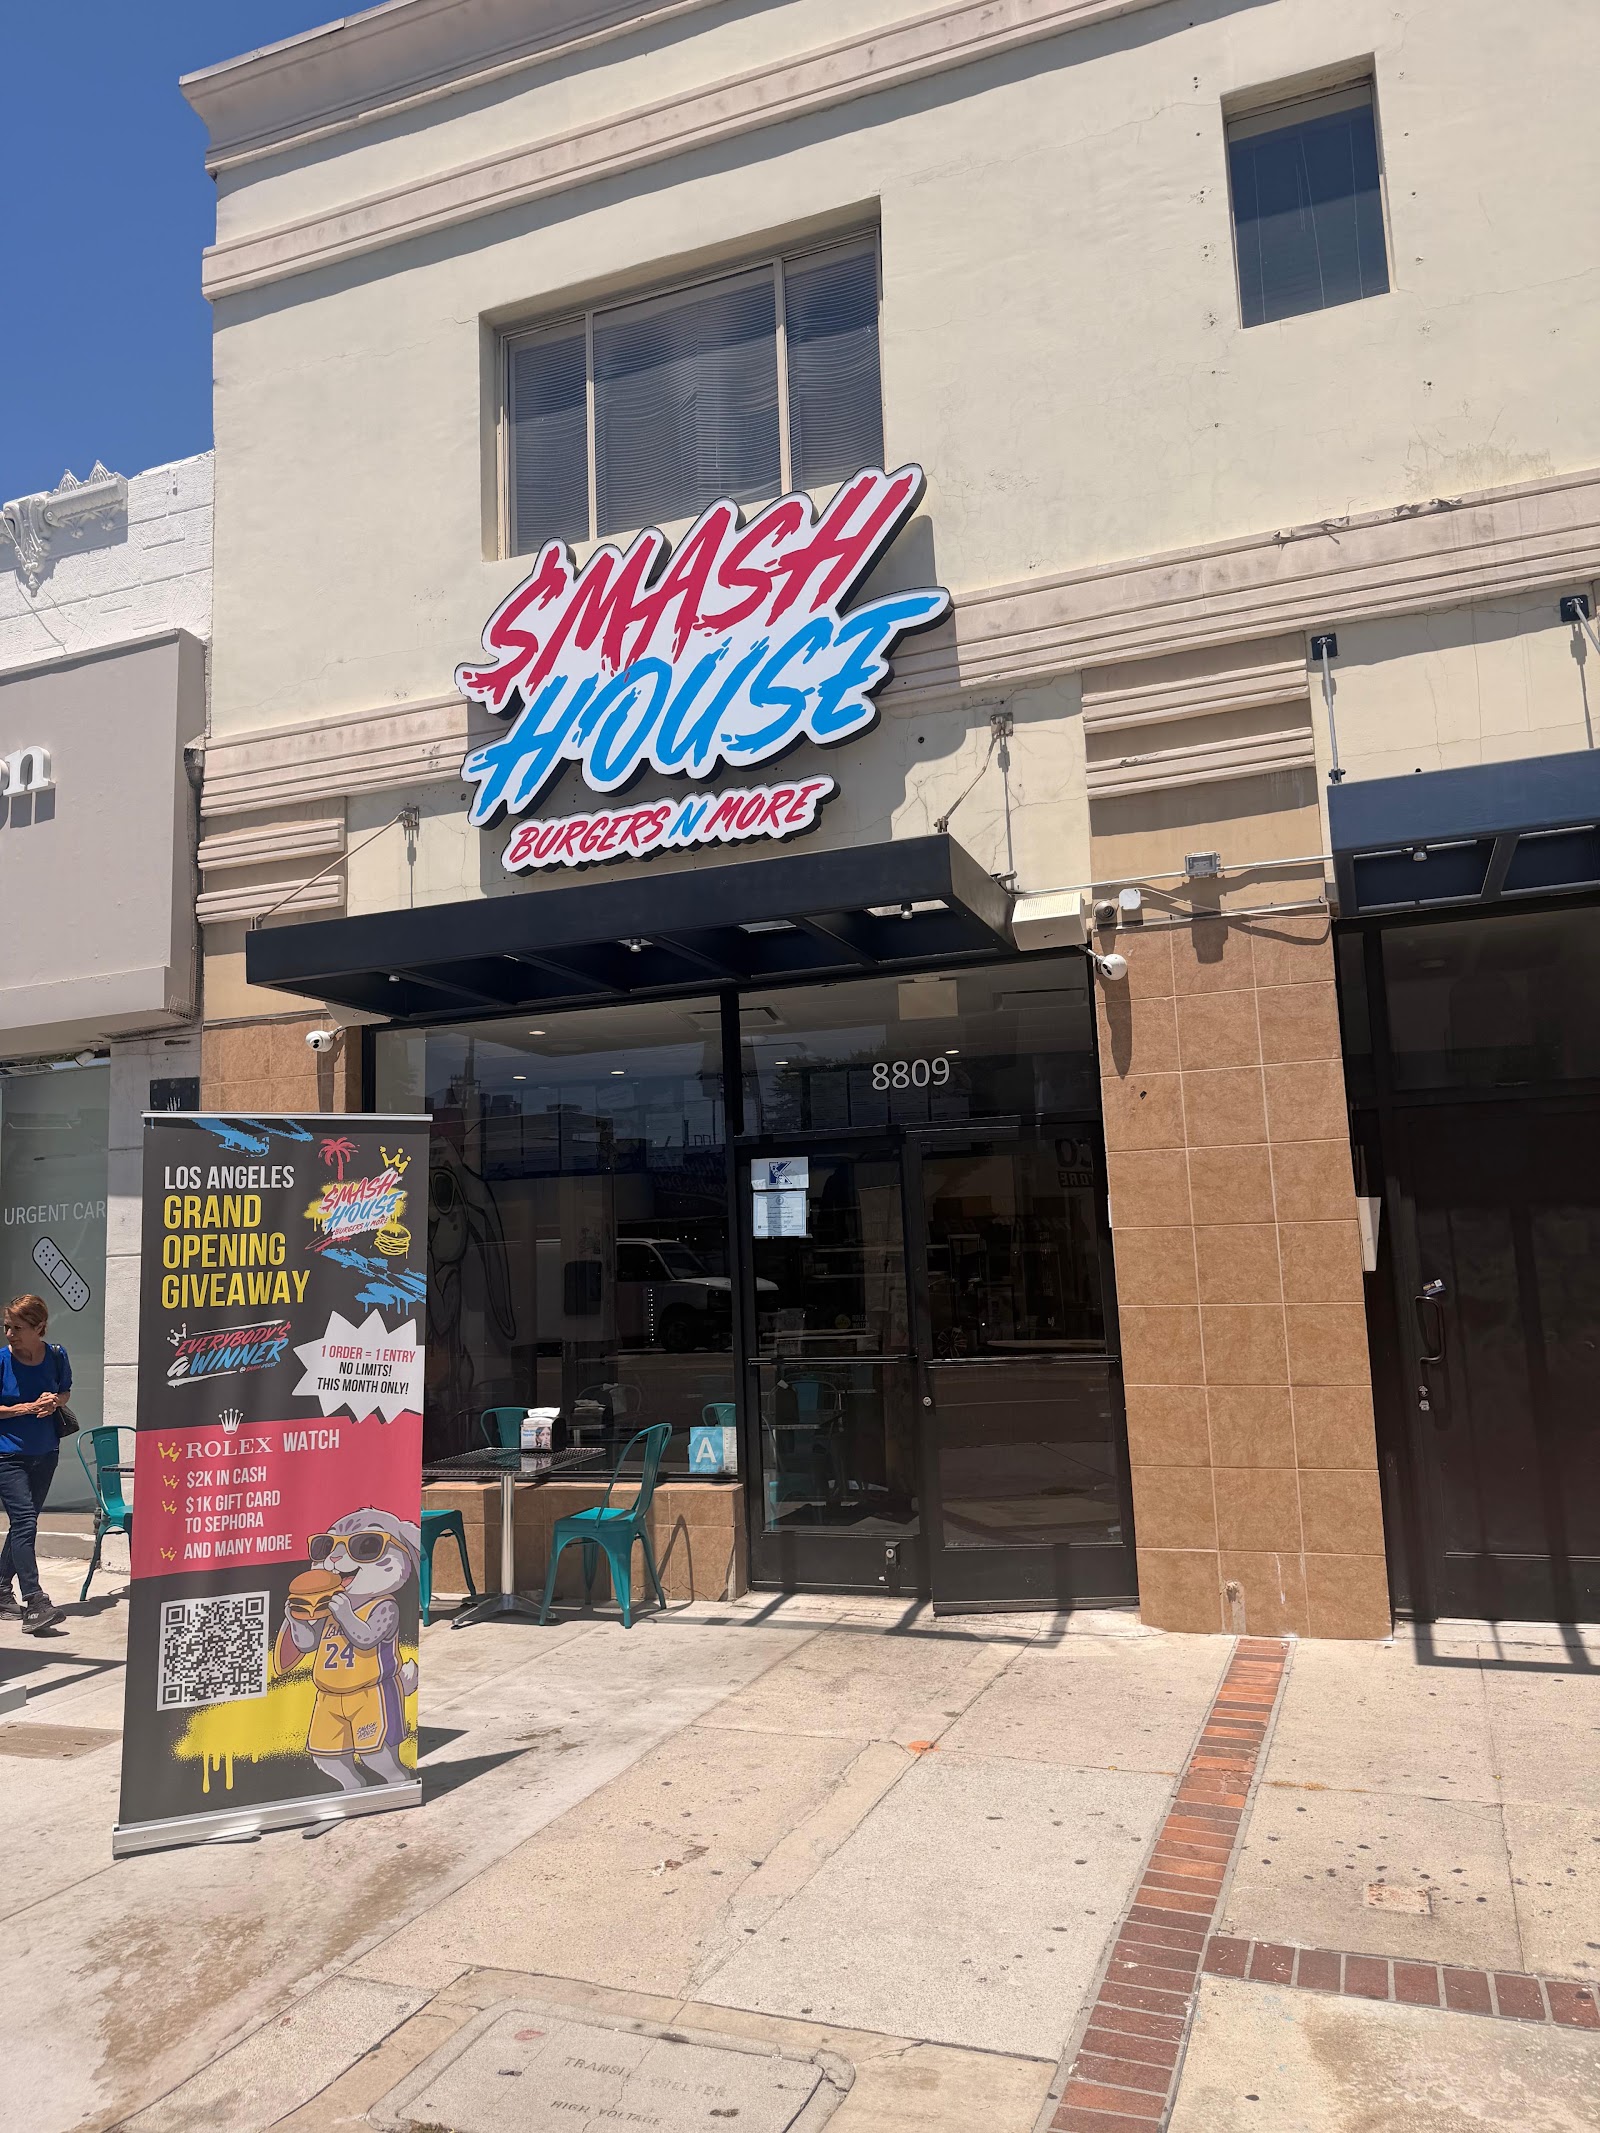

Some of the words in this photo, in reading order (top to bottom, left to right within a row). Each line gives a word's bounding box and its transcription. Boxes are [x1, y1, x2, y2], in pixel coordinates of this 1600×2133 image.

[468, 597, 942, 818] HOUSE
[0, 745, 52, 796] n
[510, 809, 669, 863] BURGERS
[669, 799, 708, 840] N
[703, 783, 825, 834] MORE
[871, 1057, 951, 1091] 8809
[163, 1165, 202, 1190] LOS
[206, 1165, 295, 1189] ANGELES
[4, 1203, 69, 1225] URGENT
[73, 1200, 106, 1220] CAR
[163, 1194, 262, 1229] GRAND
[325, 1191, 404, 1231] HOUSE
[334, 1223, 364, 1236] BURGERS
[370, 1216, 389, 1227] MORE
[162, 1232, 286, 1269] OPENING
[161, 1269, 310, 1309] GIVEAWAY
[189, 1338, 289, 1375] WINNER
[321, 1345, 327, 1358] 1
[329, 1345, 363, 1360] ORDER
[375, 1348, 381, 1361] 1
[383, 1349, 416, 1363] ENTRY
[339, 1361, 354, 1375] NO
[355, 1363, 392, 1377] LIMITS!
[317, 1377, 340, 1391] THIS
[342, 1379, 379, 1393] MONTH
[380, 1381, 409, 1395] ONLY!
[185, 1436, 273, 1459] ROLEX
[283, 1428, 340, 1453] WATCH
[695, 1436, 717, 1463] A
[186, 1470, 213, 1489] $2K
[216, 1469, 229, 1486] IN
[232, 1466, 267, 1484] CASH
[185, 1495, 212, 1515] $1K
[215, 1493, 243, 1511] GIFT
[246, 1490, 281, 1508] CARD
[185, 1517, 202, 1534] TO
[204, 1512, 264, 1533] SEPHORA
[184, 1542, 211, 1560] AND
[214, 1537, 253, 1557] MANY
[256, 1534, 292, 1552] MORE
[323, 1642, 355, 1670] 24
[551, 2100, 591, 2113] HIGH
[599, 2108, 663, 2126] VOLTAGE
